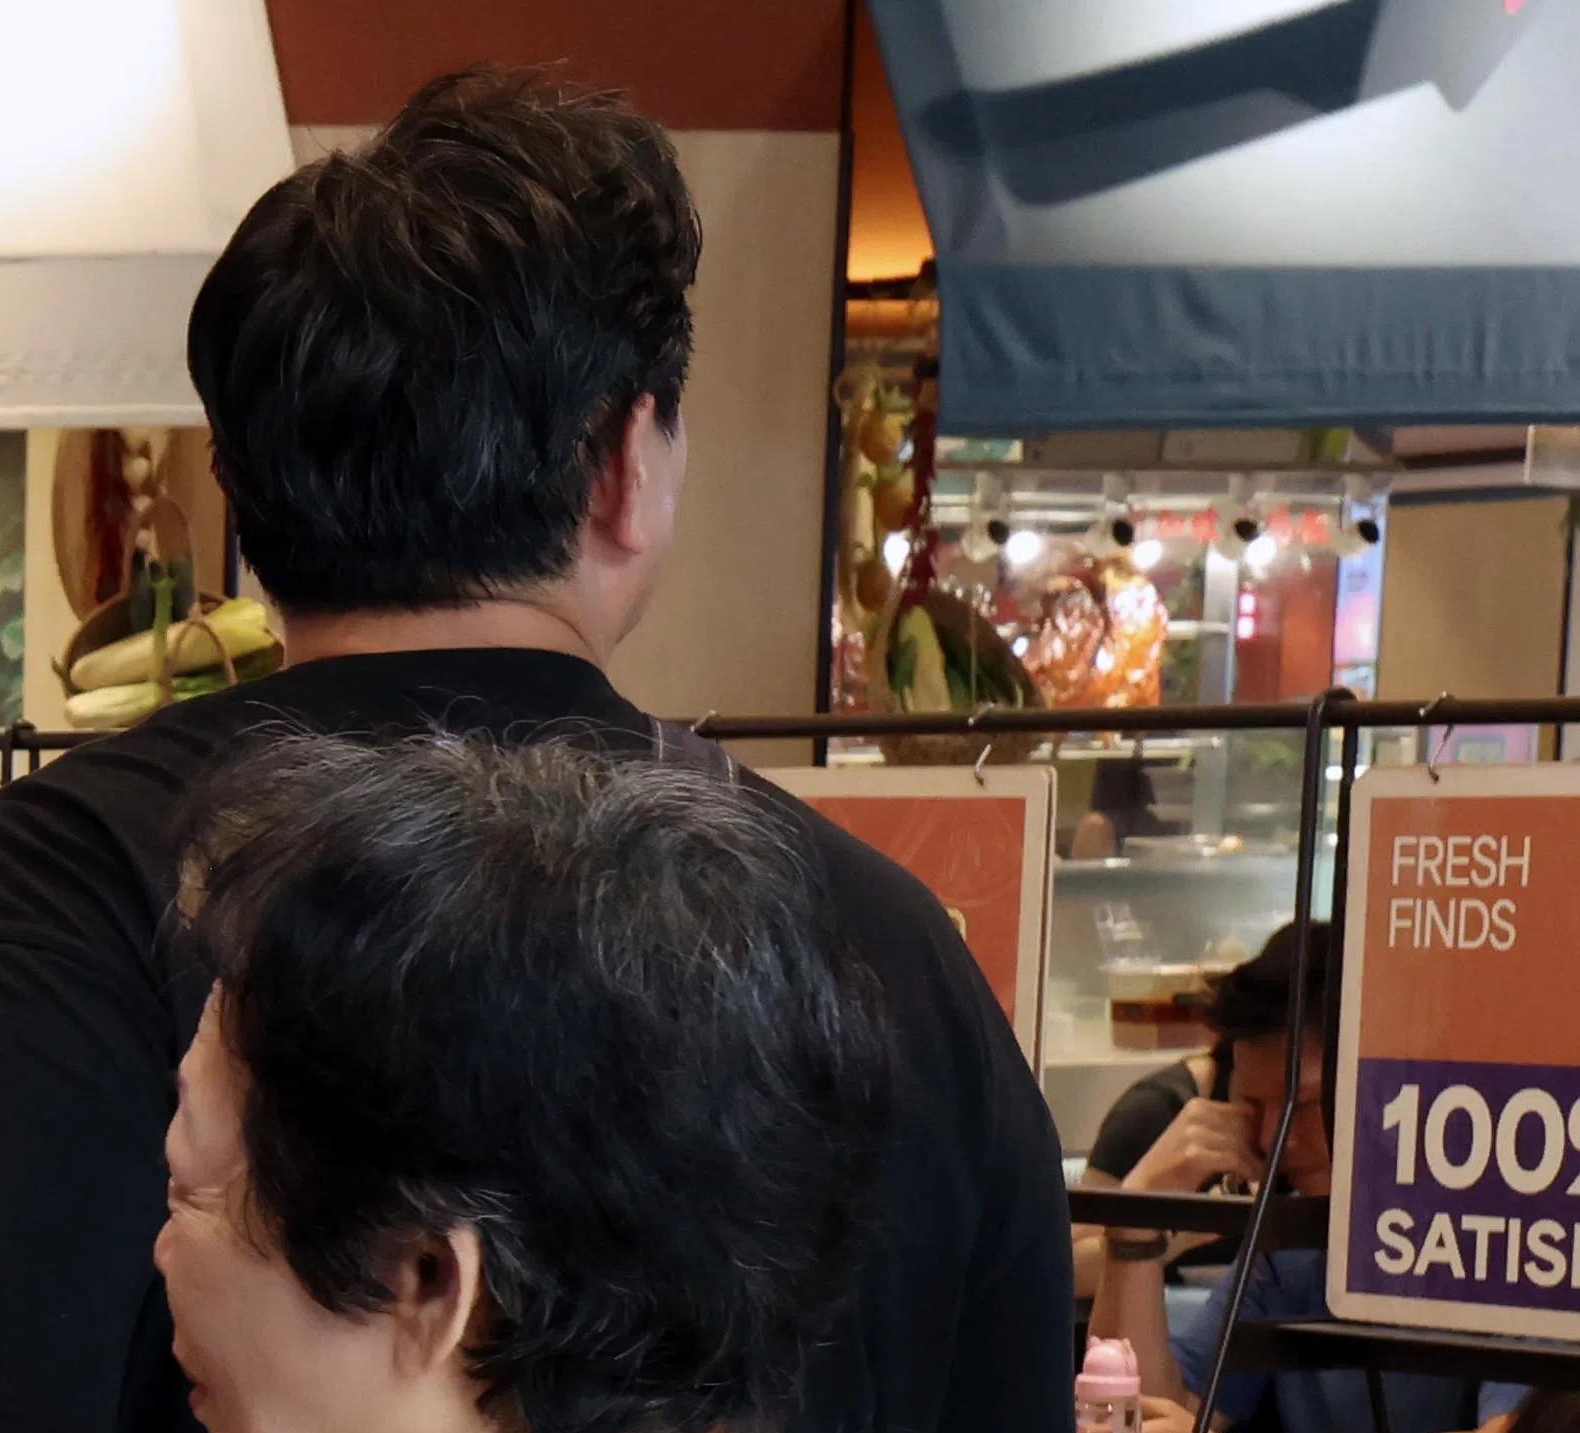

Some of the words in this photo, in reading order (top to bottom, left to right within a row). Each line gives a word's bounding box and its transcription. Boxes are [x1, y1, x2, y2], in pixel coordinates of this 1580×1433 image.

[1391, 835, 1532, 888] FRESH
[1389, 898, 1517, 953] FINDS
[1382, 1083, 1580, 1196] 100
[1373, 1207, 1580, 1290] SATIS
